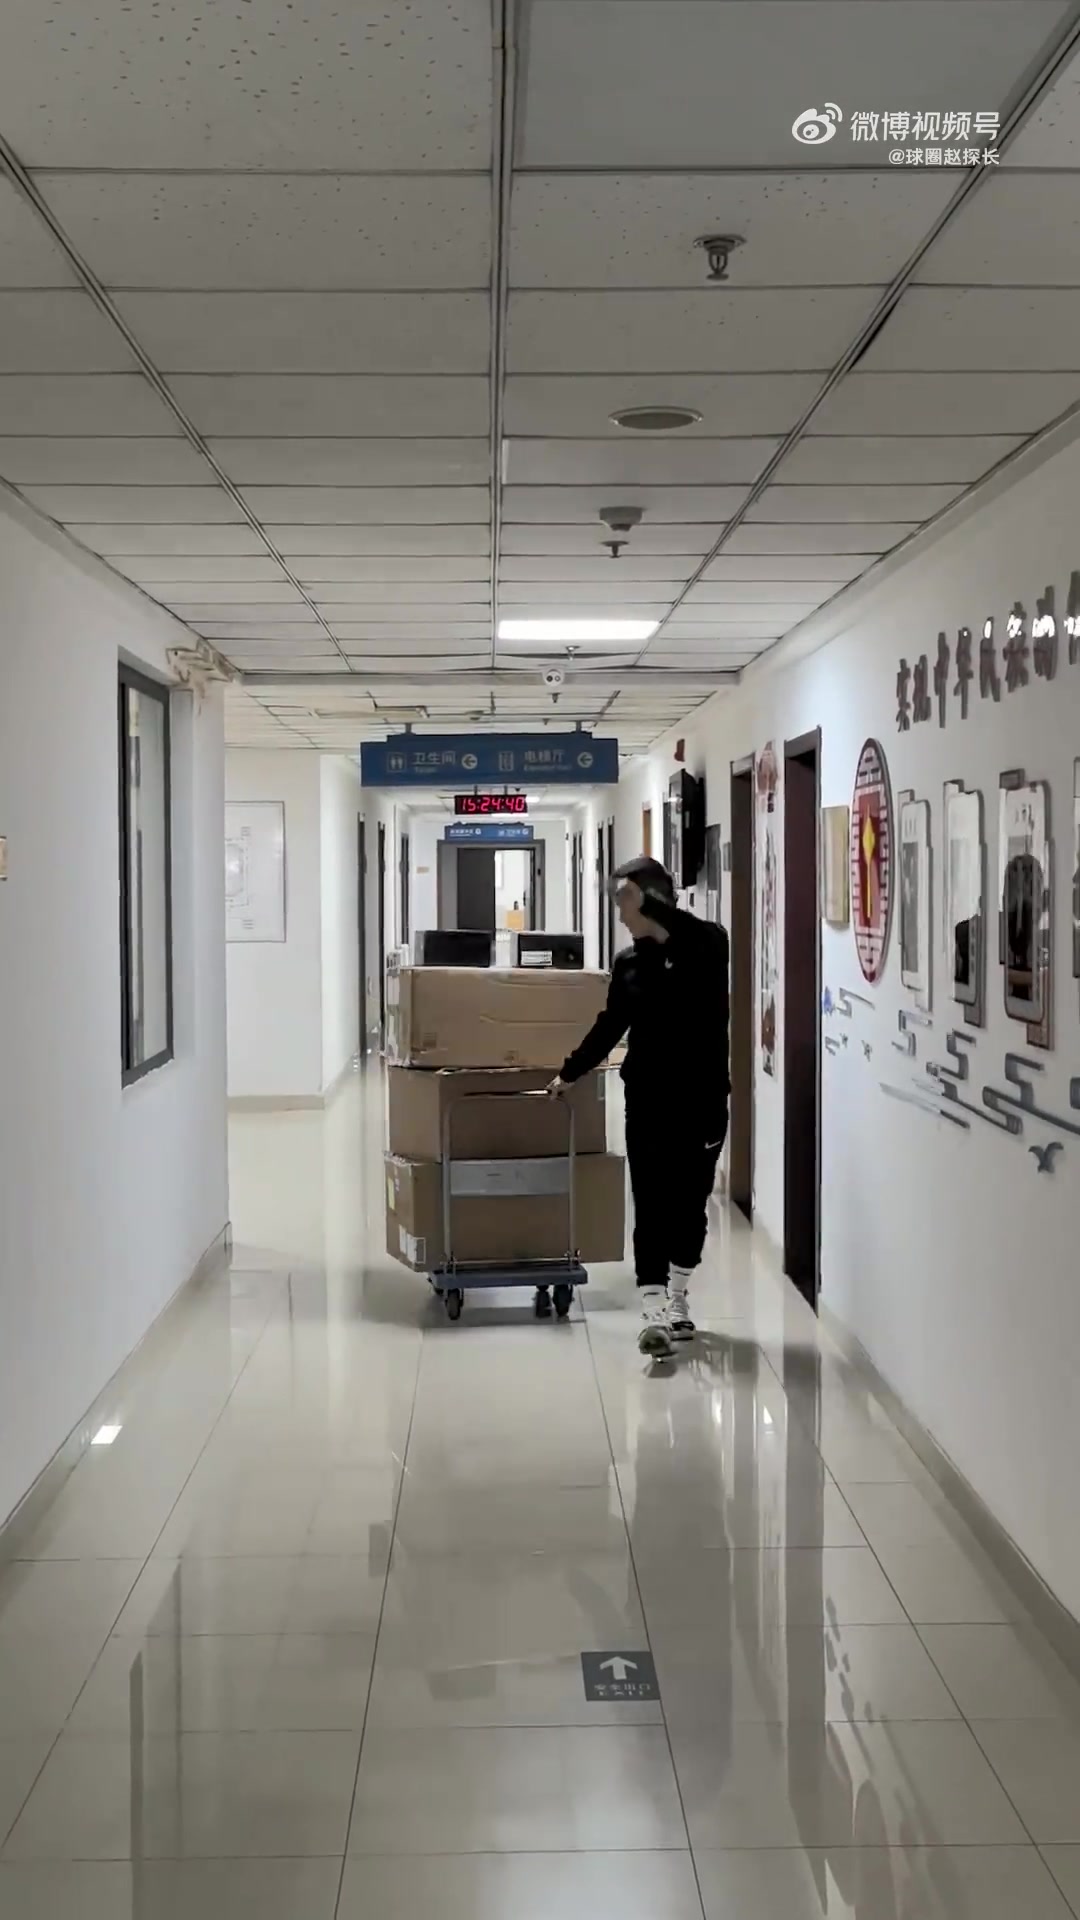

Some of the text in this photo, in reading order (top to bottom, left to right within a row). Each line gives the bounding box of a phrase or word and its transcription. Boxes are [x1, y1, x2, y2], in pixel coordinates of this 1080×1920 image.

[412, 751, 456, 765] 卫生间
[462, 796, 525, 812] 15:24:40
